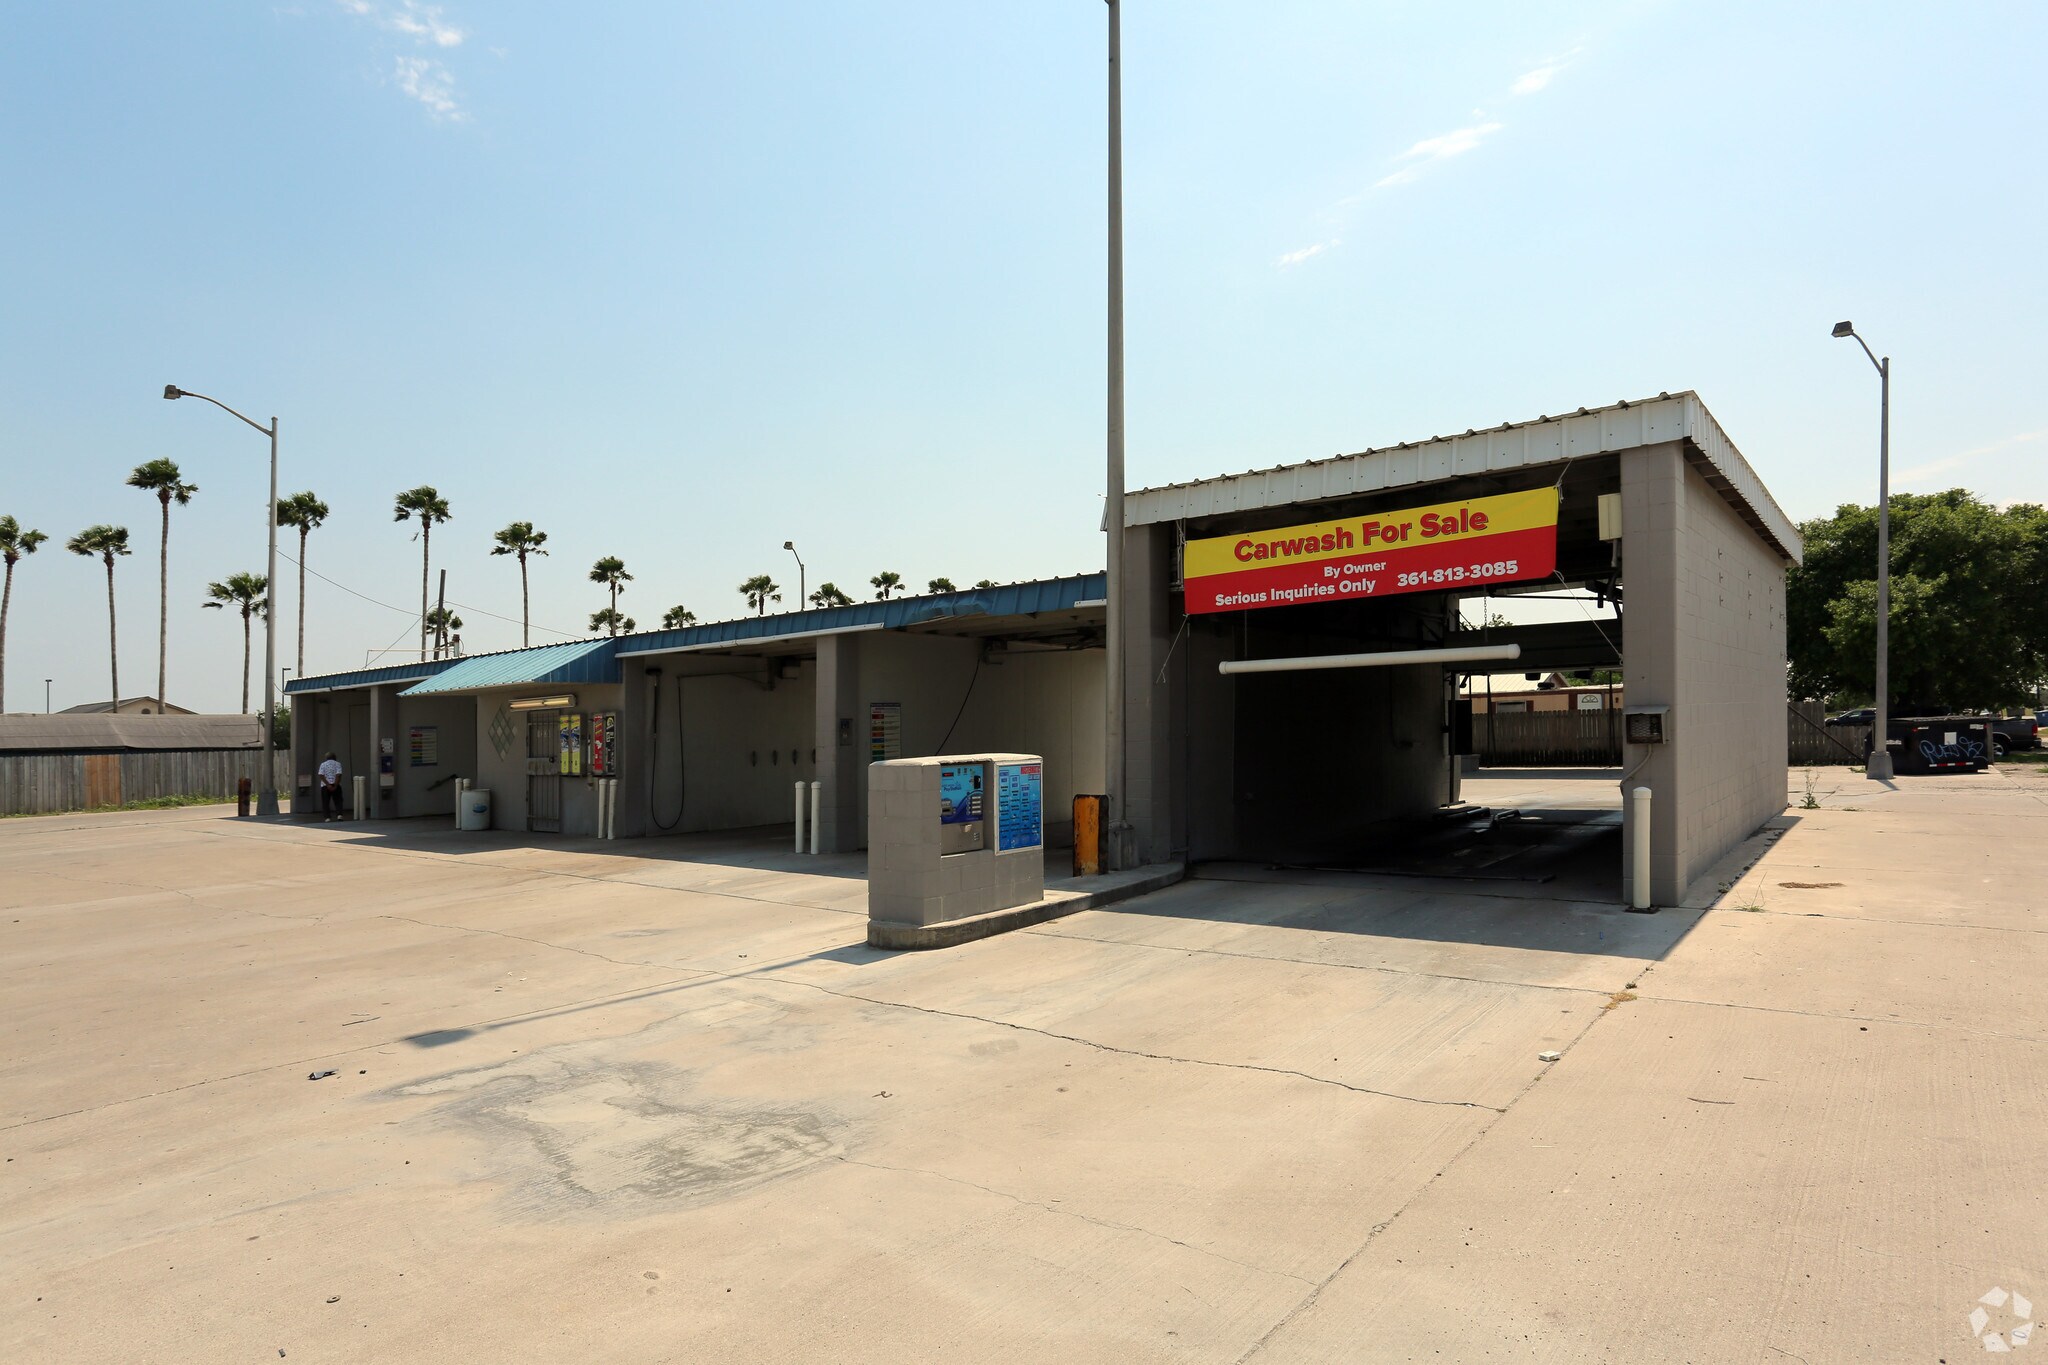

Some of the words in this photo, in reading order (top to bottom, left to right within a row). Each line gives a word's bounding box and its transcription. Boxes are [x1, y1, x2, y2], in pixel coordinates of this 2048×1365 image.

[1234, 527, 1353, 562] Carwash
[1362, 521, 1412, 546] For
[1420, 508, 1489, 538] Sale
[1324, 566, 1341, 578] By
[1343, 562, 1387, 575] Owner
[1397, 560, 1518, 587] 361-813-3085
[1215, 592, 1267, 606] Serious
[1271, 583, 1335, 601] Inquiries
[1339, 578, 1376, 593] Only
